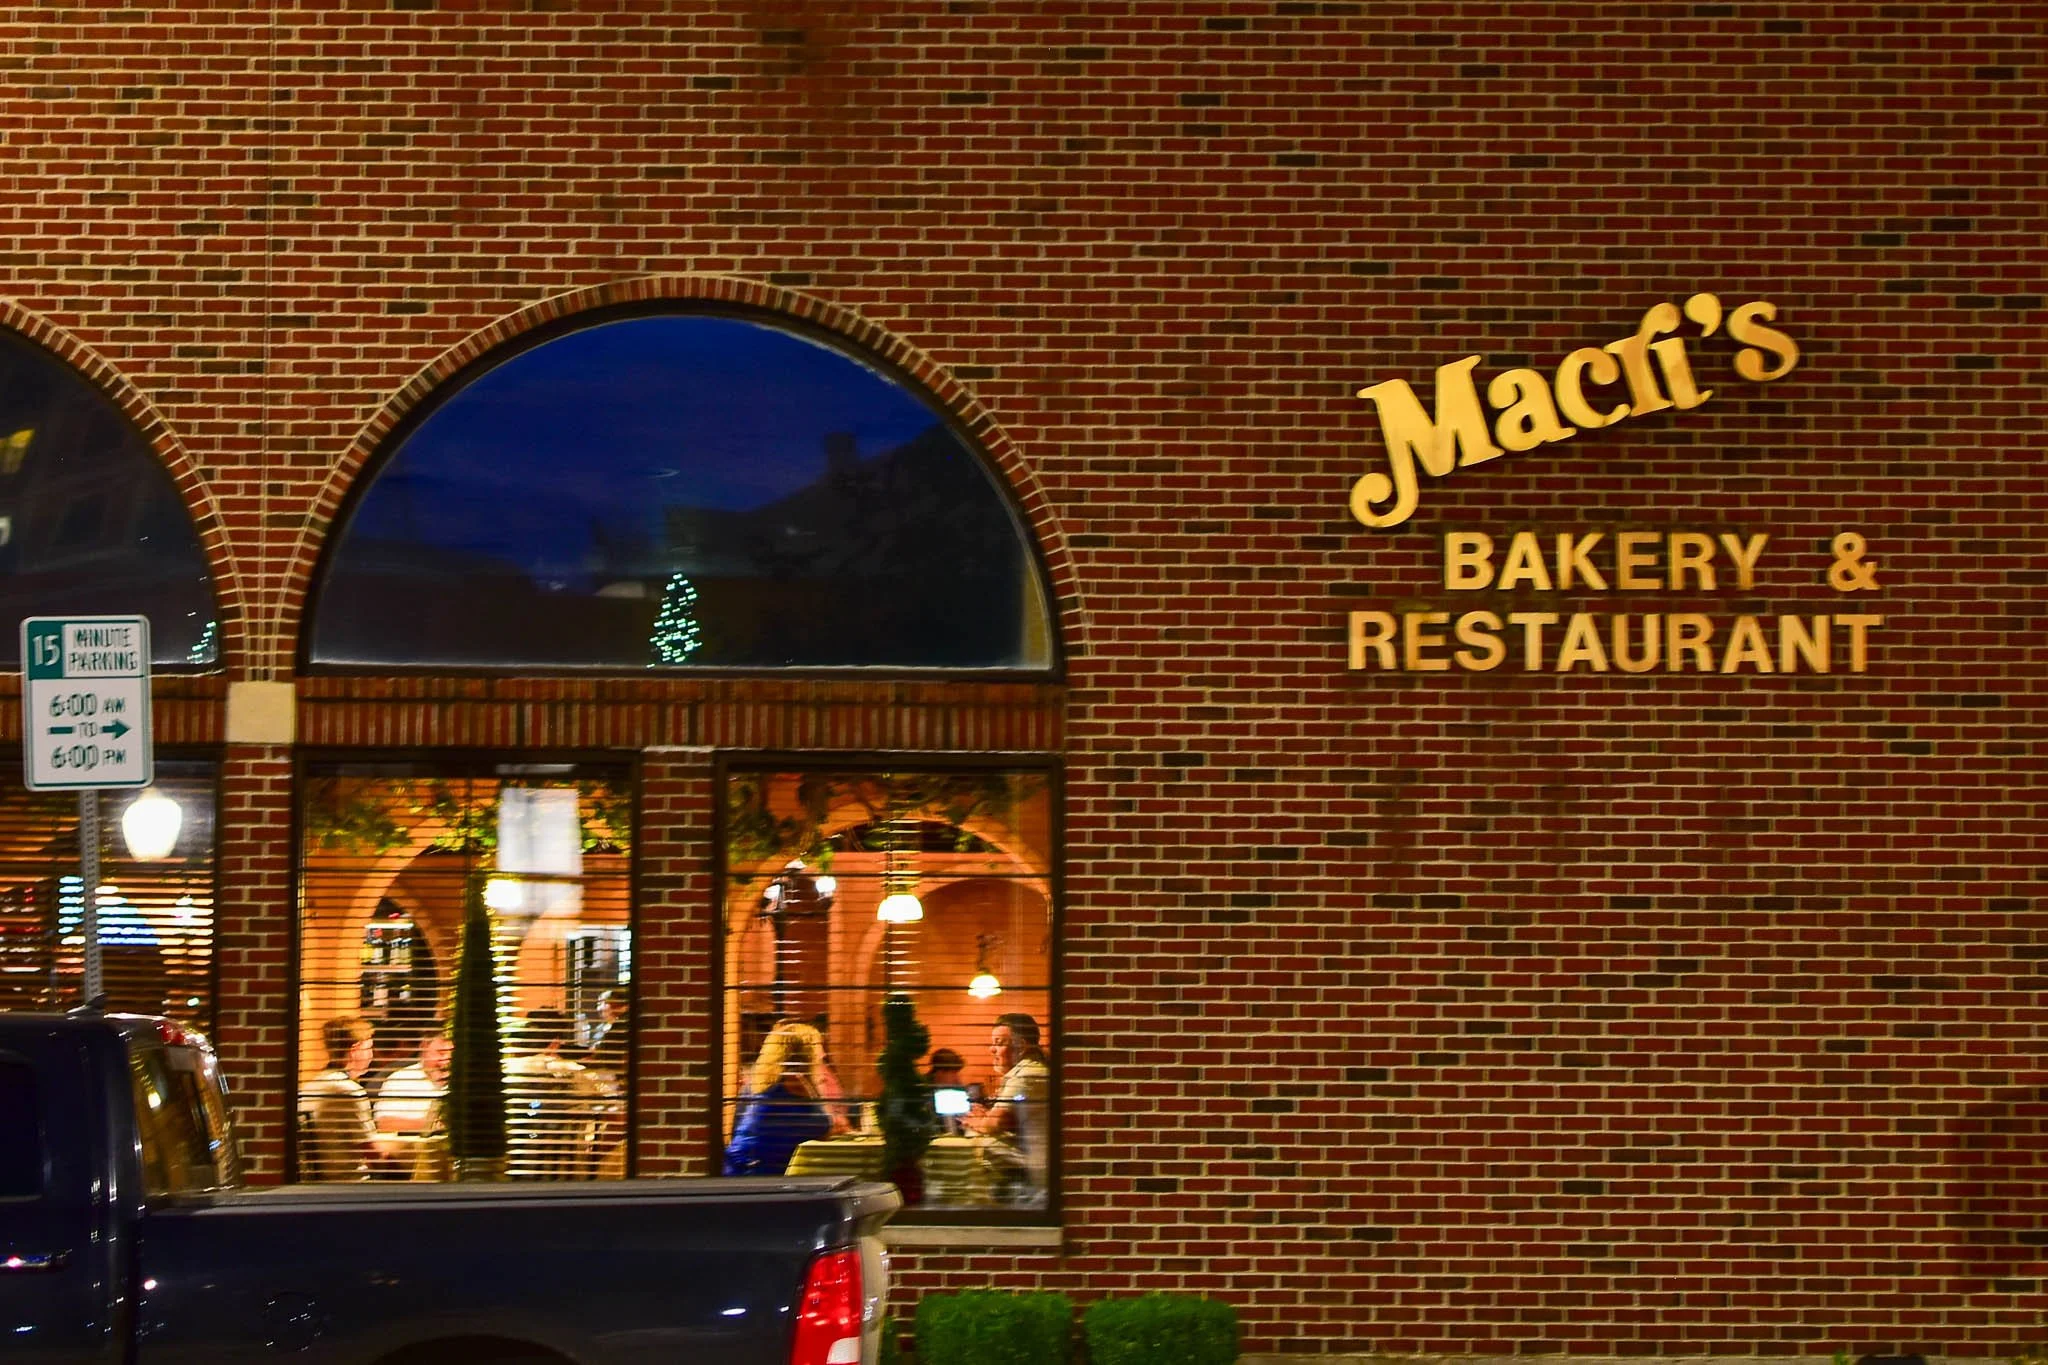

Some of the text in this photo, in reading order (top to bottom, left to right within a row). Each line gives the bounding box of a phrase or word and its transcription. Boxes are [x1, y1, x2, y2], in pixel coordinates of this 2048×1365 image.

[1350, 293, 1799, 527] Macri's
[1445, 531, 1881, 592] BAKERY &
[33, 635, 60, 666] 15
[73, 627, 132, 649] MINUTE
[1348, 610, 1884, 674] RESTAURANT
[69, 651, 138, 672] PARKING
[50, 693, 126, 717] 6:00 AM
[79, 722, 99, 738] TO
[51, 744, 127, 770] 6:00 PM
